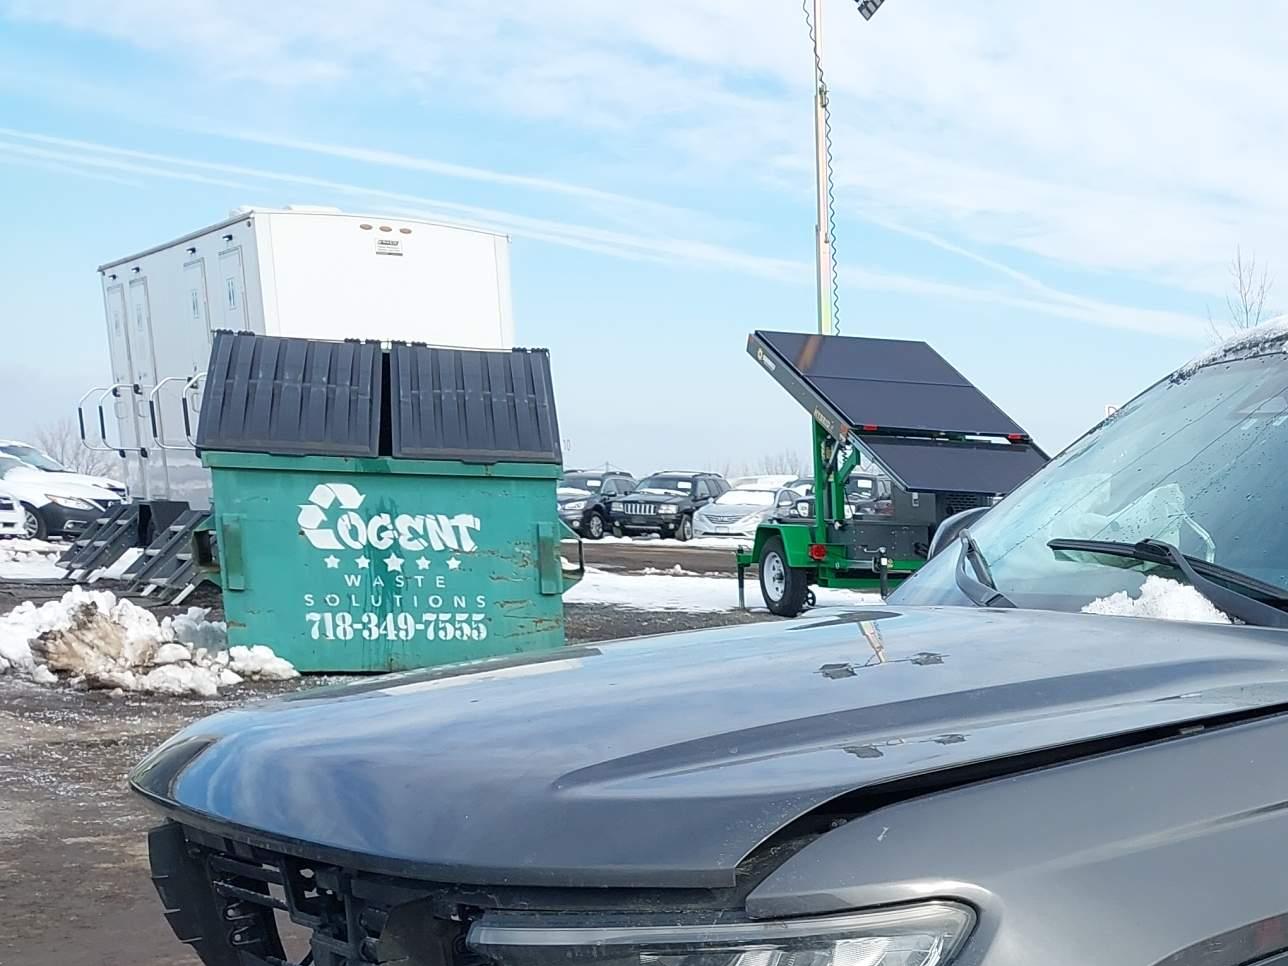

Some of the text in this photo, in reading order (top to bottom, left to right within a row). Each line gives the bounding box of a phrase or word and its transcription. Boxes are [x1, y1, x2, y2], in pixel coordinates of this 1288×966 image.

[344, 574, 447, 588] WASTE
[304, 593, 487, 608] SOLUTIONS
[305, 611, 488, 641] 718-349-7555
